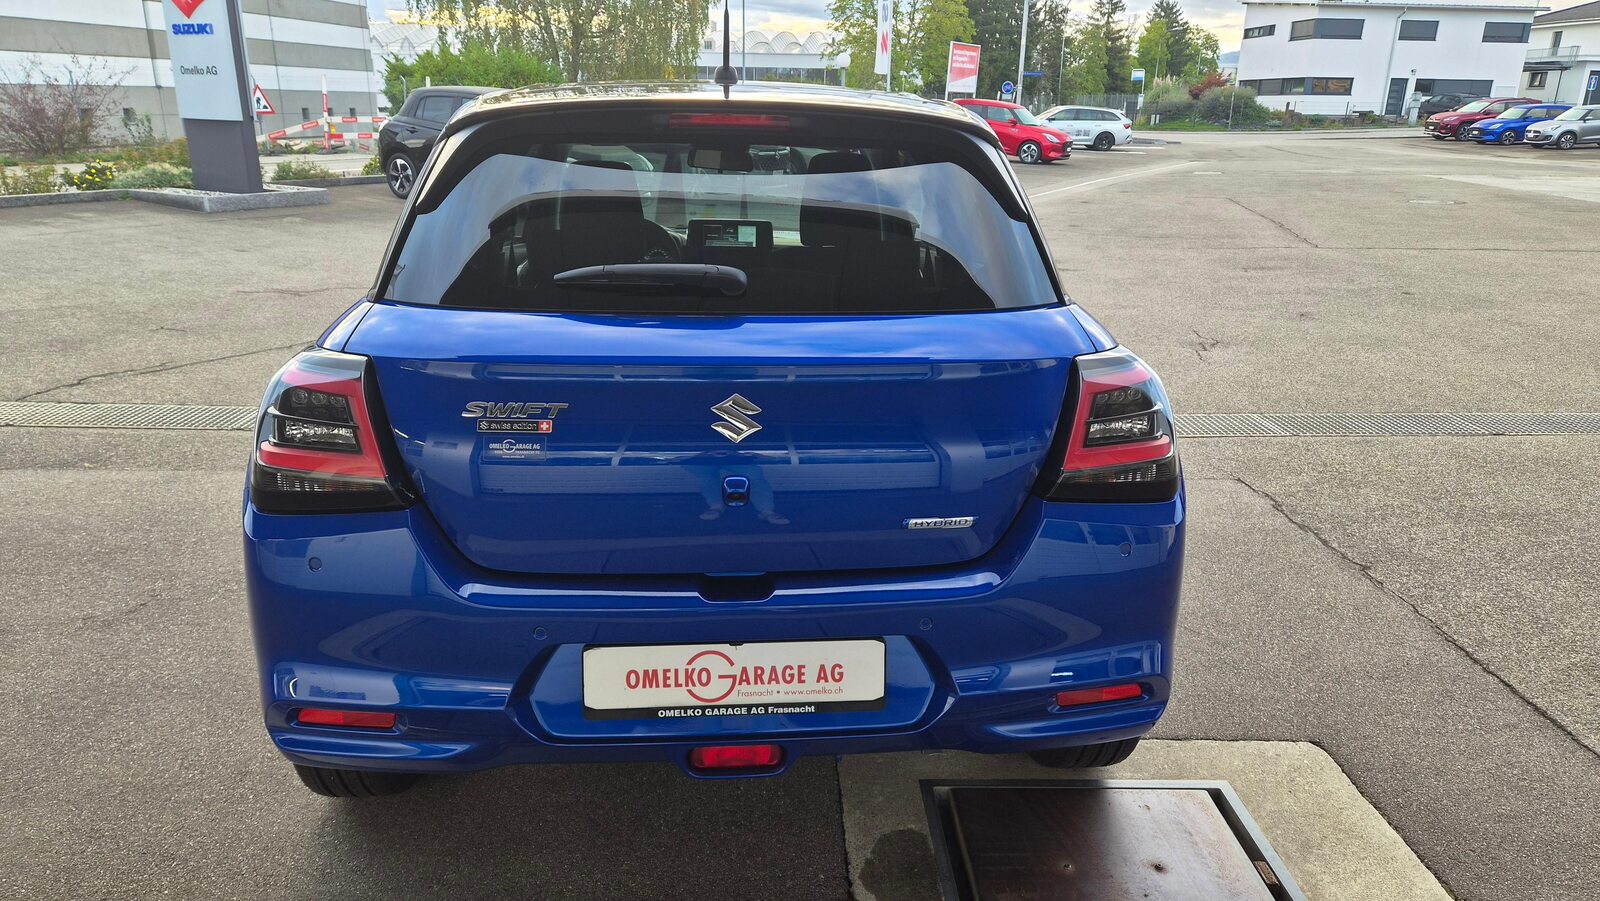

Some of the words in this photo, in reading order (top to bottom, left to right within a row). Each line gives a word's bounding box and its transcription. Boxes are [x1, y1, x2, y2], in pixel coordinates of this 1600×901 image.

[171, 23, 214, 35] SUZUKI
[180, 65, 204, 75] Omelko
[206, 66, 218, 75] AG
[461, 401, 569, 418] SWIFT
[490, 422, 511, 430] swiss
[512, 422, 537, 430] edition
[913, 518, 969, 528] HYBRID
[625, 667, 711, 689] OMELKO
[816, 663, 844, 683] AG
[737, 688, 774, 698] Frasnacht
[783, 686, 844, 696] www.omelko.ch
[658, 708, 702, 717] OMELKO
[705, 707, 748, 716] GARAGE
[750, 706, 766, 715] AG
[768, 705, 815, 714] Frasnacht
